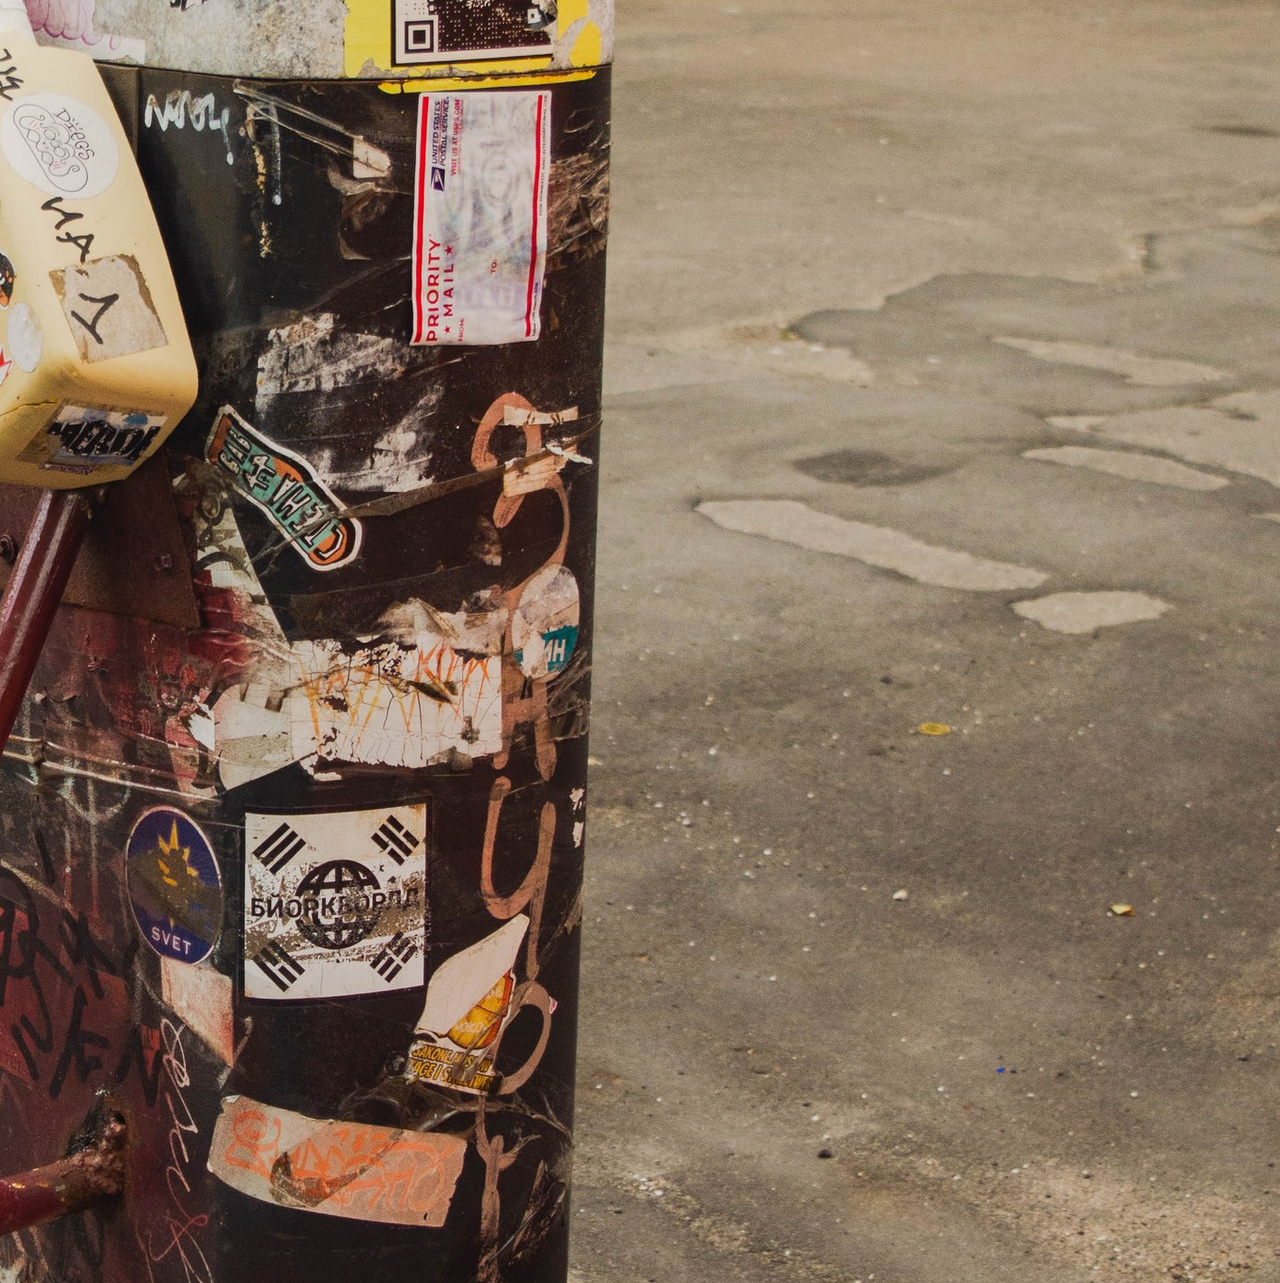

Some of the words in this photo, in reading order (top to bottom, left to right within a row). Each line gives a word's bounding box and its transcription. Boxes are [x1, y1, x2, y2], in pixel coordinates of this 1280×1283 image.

[432, 100, 440, 131] STATES
[431, 132, 439, 165] UNITED
[440, 134, 448, 166] POSTAL
[451, 147, 458, 157] US
[452, 136, 458, 146] AT
[490, 258, 498, 275] TO:
[425, 240, 441, 342] PRIORITY
[443, 263, 455, 317] MAIL
[457, 317, 465, 342] FROM:
[151, 926, 192, 955] SVET
